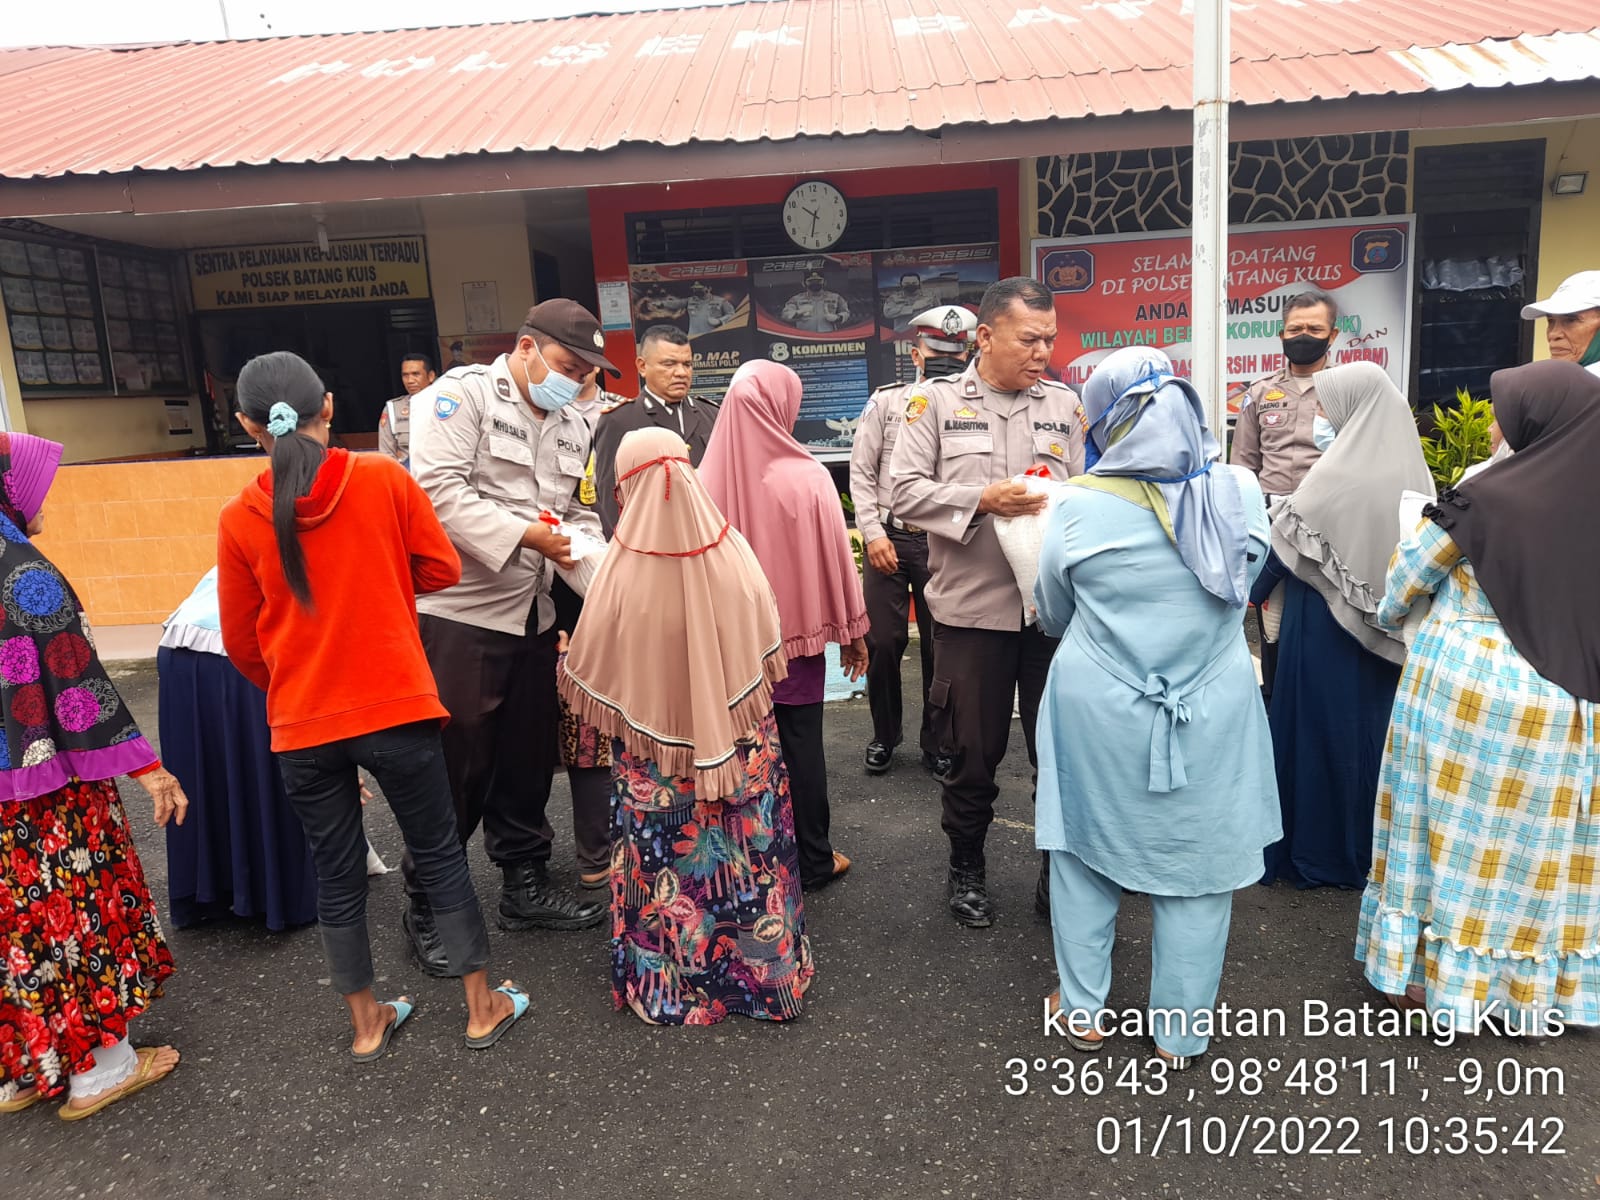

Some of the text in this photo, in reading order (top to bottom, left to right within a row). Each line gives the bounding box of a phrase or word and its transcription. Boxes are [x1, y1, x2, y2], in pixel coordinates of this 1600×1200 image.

[268, 27, 803, 84] POLSEK
[796, 190, 804, 198] 11
[808, 184, 817, 192] 12
[824, 187, 828, 195] 1
[788, 200, 797, 208] 10
[833, 196, 839, 204] 2
[787, 215, 792, 223] 9
[839, 209, 844, 217] 3
[791, 227, 796, 235] 8
[827, 233, 832, 241] 5
[802, 236, 807, 245] 7
[815, 240, 820, 248] 6
[195, 250, 237, 275] SENTRA
[239, 247, 301, 267] PELAYANAN
[370, 241, 420, 263] TERPADU
[1132, 245, 1316, 273] SELAM DATANG
[241, 265, 377, 288] POLSEK BATANG KUIS
[1101, 264, 1342, 296] DI POLSE ATANG KUIS
[215, 281, 409, 305] KAMI SIAP MELAYANI ANDA
[1135, 302, 1188, 321] ANDA
[1081, 328, 1156, 348] WILAYAH
[1346, 327, 1388, 347] DAN
[707, 351, 740, 361] MAP
[772, 342, 790, 361] 8
[792, 342, 866, 356] KOMITMEN
[1227, 354, 1257, 374] RSIH
[1034, 421, 1069, 435] POLRI
[557, 438, 582, 456] POLRI
